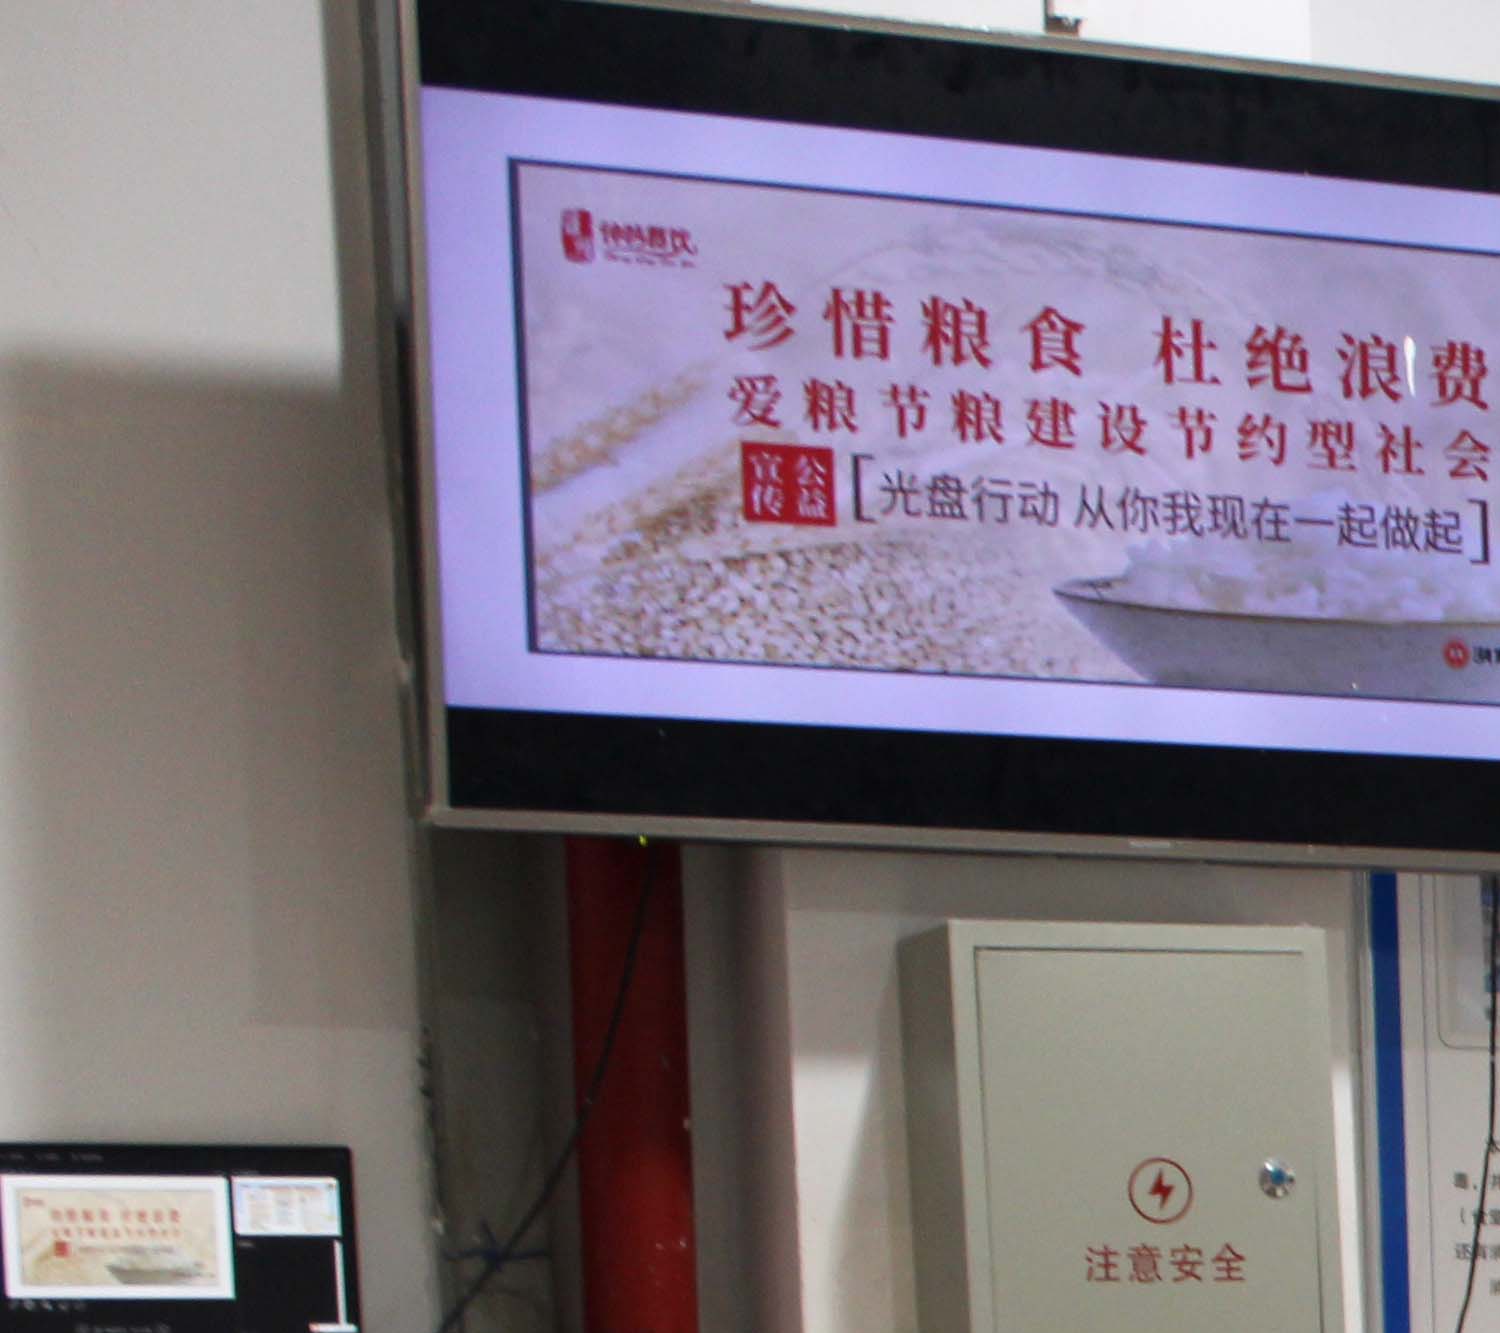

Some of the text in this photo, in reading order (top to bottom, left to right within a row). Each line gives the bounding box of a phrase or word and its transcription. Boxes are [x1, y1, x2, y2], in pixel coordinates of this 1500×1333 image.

[723, 280, 1491, 412] 珍惜粮食 杜绝浪费
[726, 373, 1493, 484] 爱粮节粮建设节约型社会
[1085, 1242, 1247, 1283] 注意安全
